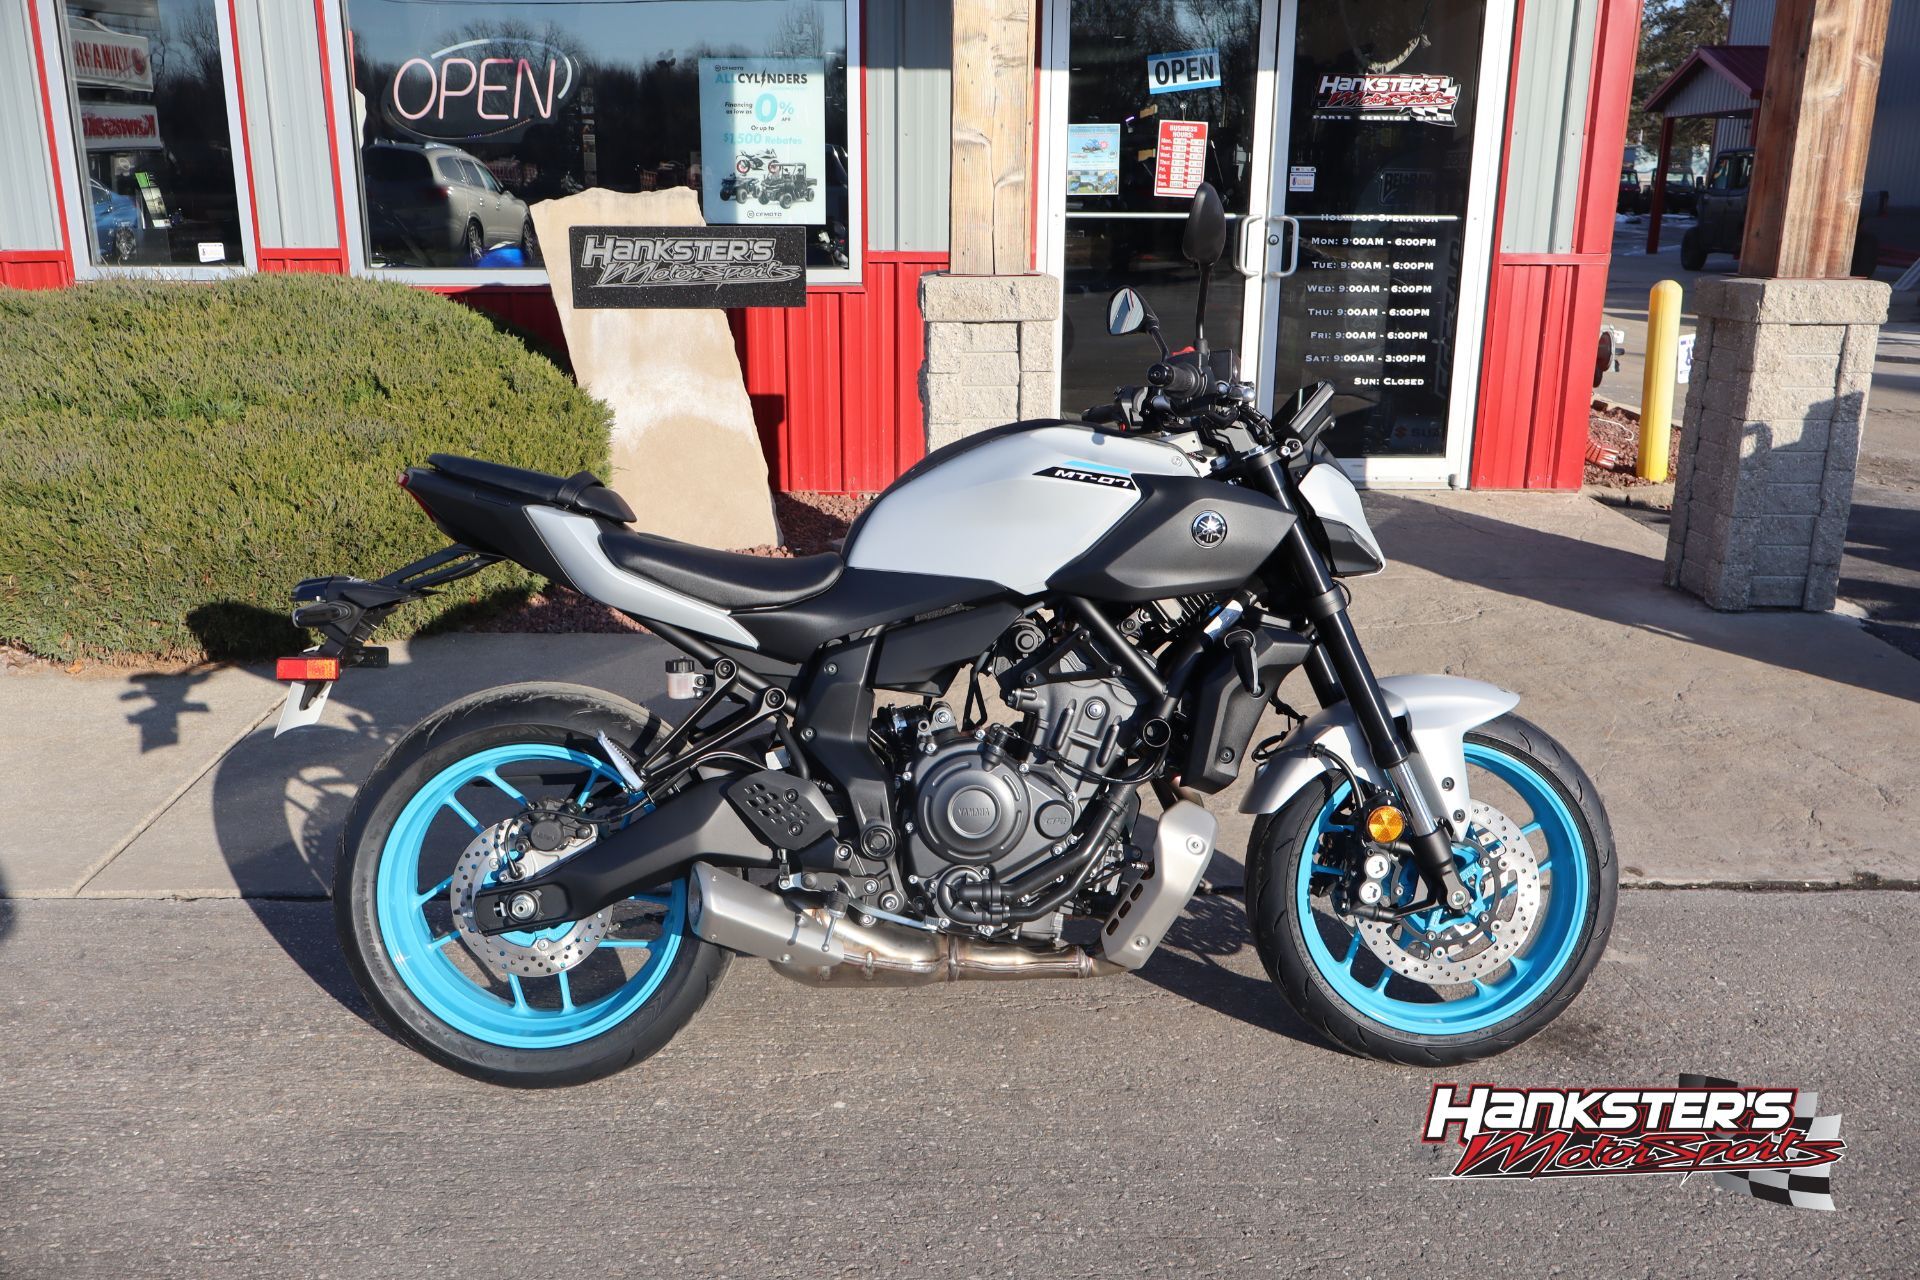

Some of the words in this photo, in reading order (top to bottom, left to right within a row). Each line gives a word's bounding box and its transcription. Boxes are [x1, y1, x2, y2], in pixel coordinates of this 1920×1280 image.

[1155, 56, 1214, 85] OPEN
[393, 57, 556, 120] OPEN
[724, 101, 753, 110] Financing
[765, 135, 803, 145] Rebates
[1394, 238, 1437, 247] 6:00PM
[1340, 261, 1382, 270] 9:00AM
[1392, 262, 1434, 270] 6:00PM
[1338, 285, 1380, 293] 9:00AM
[1391, 285, 1432, 294] 6:00PM
[1337, 308, 1378, 317] 9:00AM
[1389, 308, 1430, 317] 6:00PM
[1335, 331, 1377, 340] 9:00AM
[1387, 331, 1428, 340] 6:00PM
[1333, 354, 1375, 363] 9:00AM
[1385, 354, 1426, 363] 3:00PM
[1054, 469, 1131, 487] MT-07
[959, 807, 990, 817] YAMAHA
